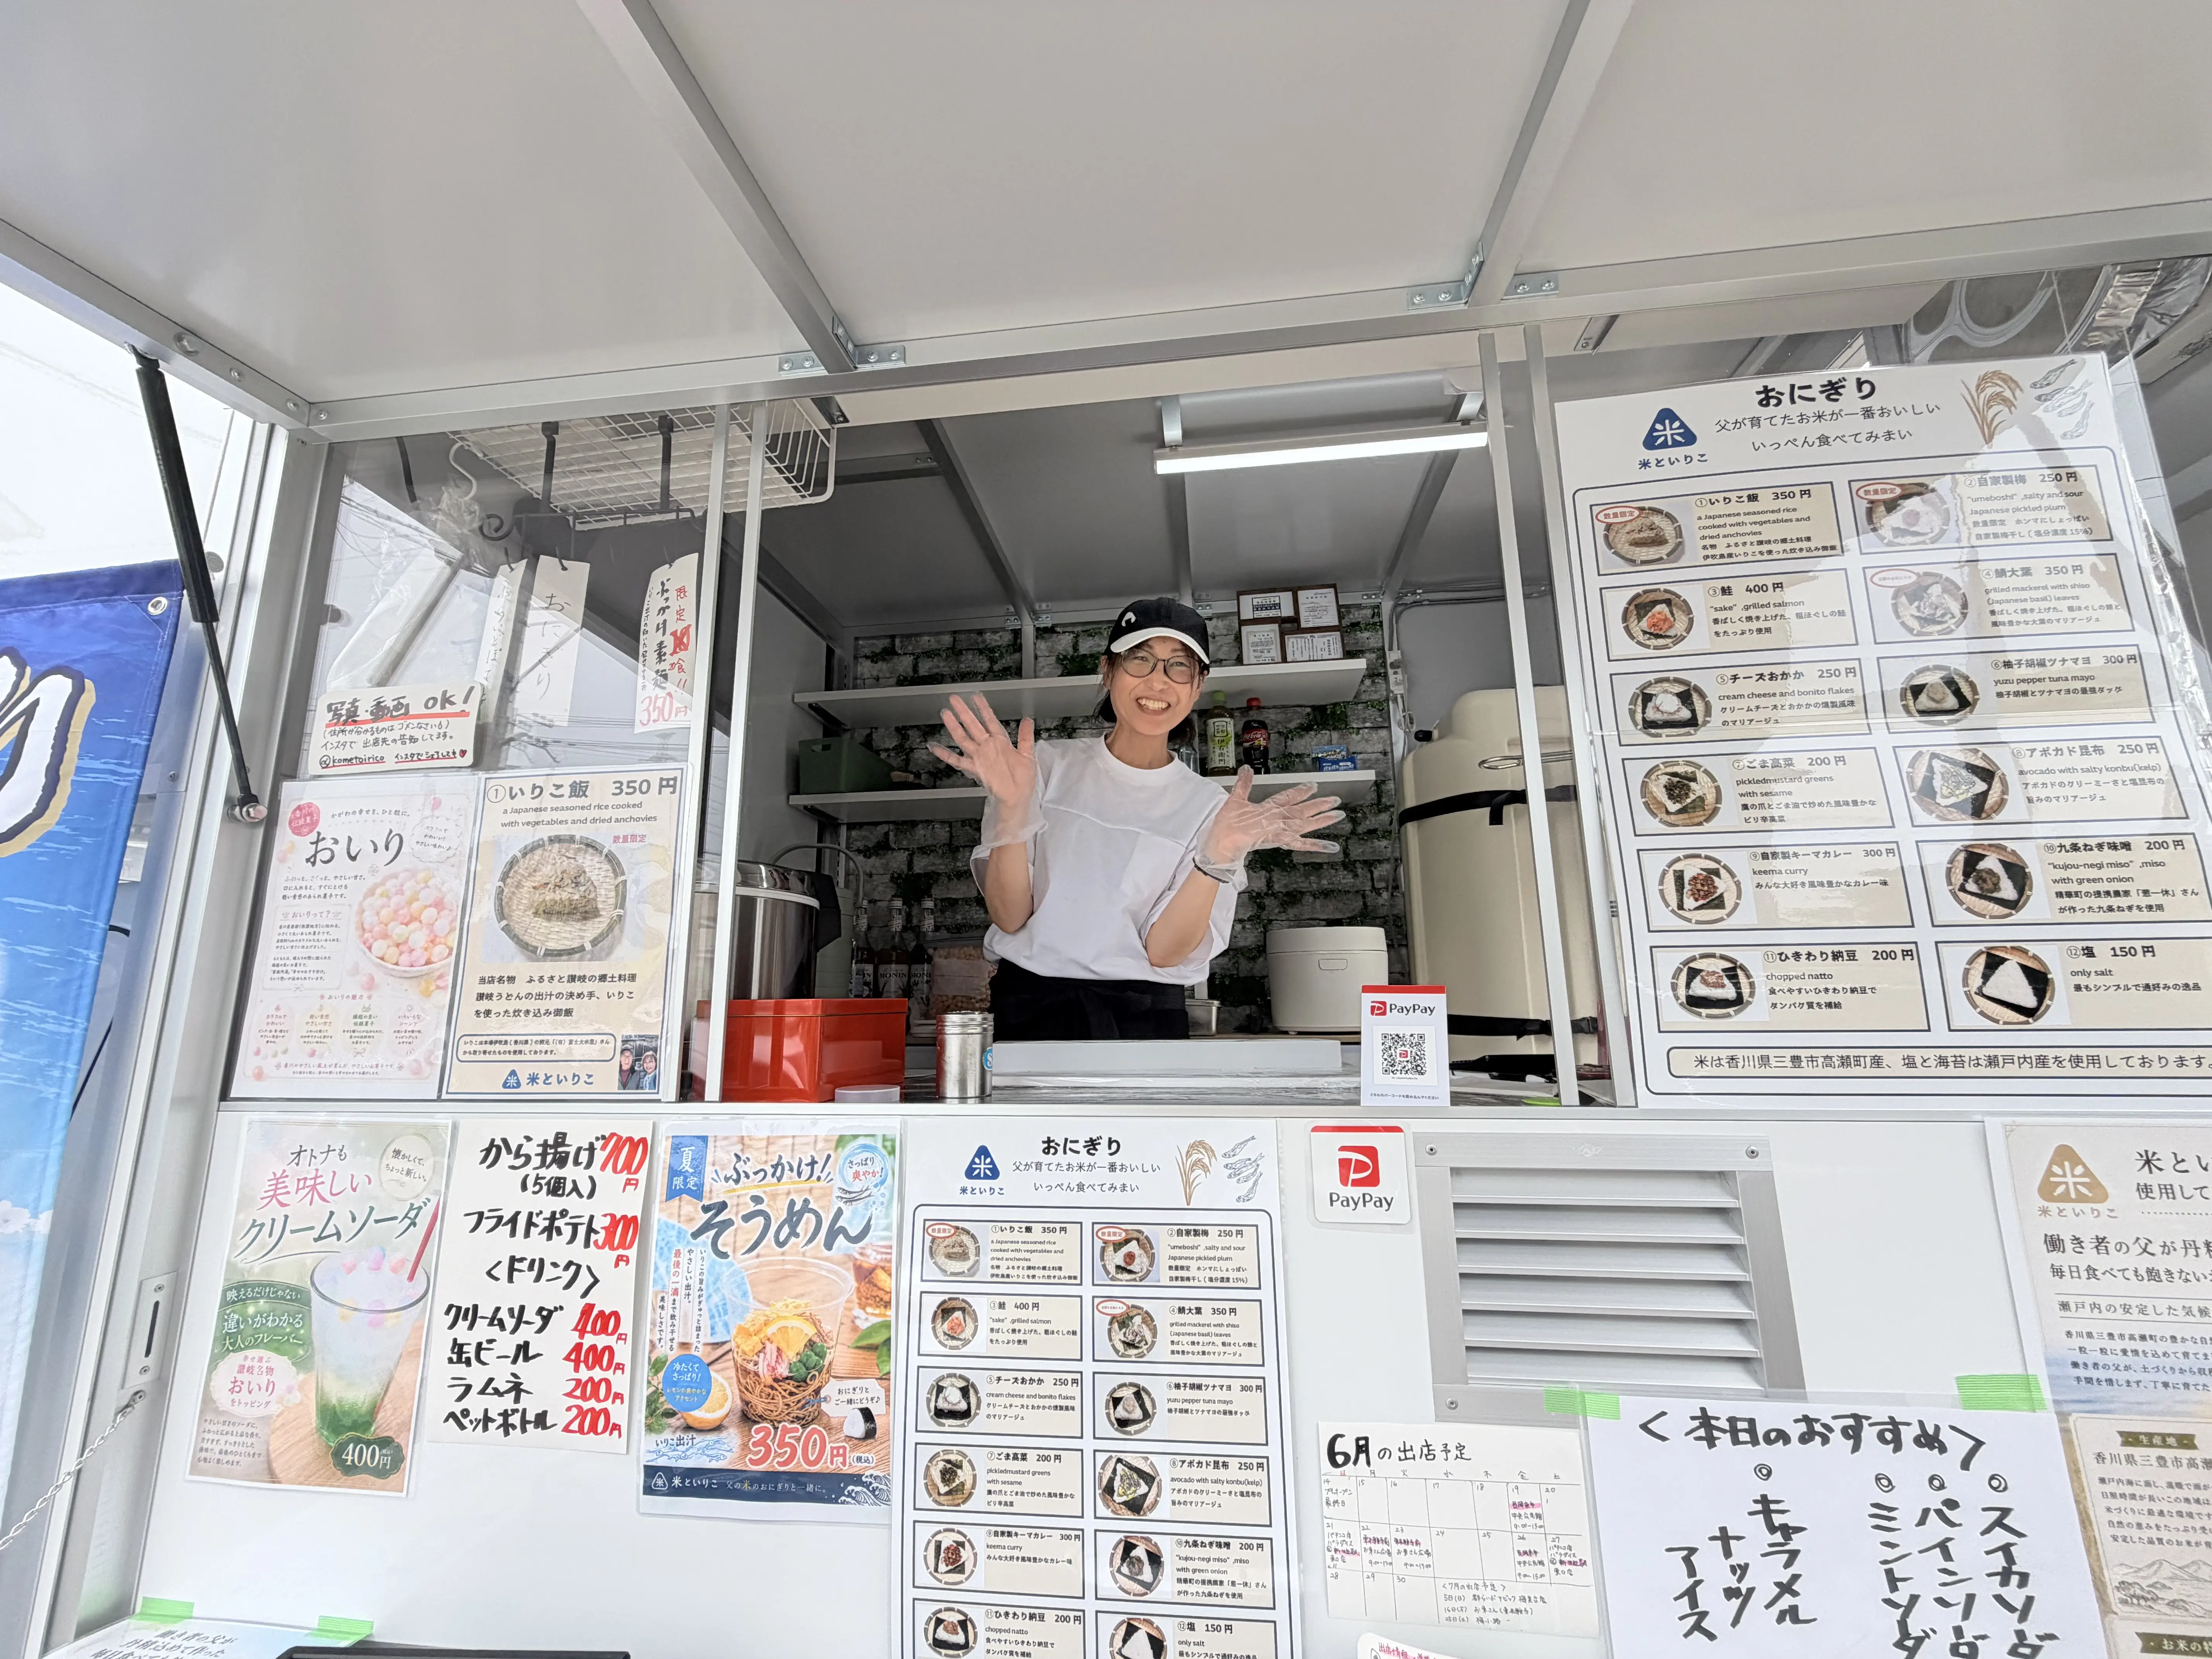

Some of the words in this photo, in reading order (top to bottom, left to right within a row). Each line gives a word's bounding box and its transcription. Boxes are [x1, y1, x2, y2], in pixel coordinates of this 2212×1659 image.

[1756, 376, 1875, 407] おにぎり
[1715, 404, 1940, 433] 父が育てたお米が一番おいしい
[1752, 430, 1912, 451] いっぺん食べてみまい
[1638, 453, 1708, 470] 米といりこ
[640, 692, 688, 726] 350円
[1807, 757, 1831, 766] 200
[1834, 755, 1846, 766] 円
[611, 779, 651, 796] 350
[658, 776, 677, 795] 円
[1736, 776, 1802, 787] pickledmustard
[1805, 775, 1834, 784] greens
[509, 807, 548, 815] Japanese
[550, 803, 592, 812] seasoned
[611, 801, 642, 809] cooked
[521, 818, 568, 828] vegetables
[589, 816, 612, 824] dried
[614, 814, 657, 823] anchovies
[306, 828, 403, 867] おいり
[613, 834, 646, 844] 数量限定
[1784, 868, 1808, 877] curry
[1872, 950, 1897, 960] 200
[1901, 949, 1914, 961] 円
[2110, 946, 2137, 957] 150
[2141, 945, 2156, 958] 円
[478, 975, 516, 985] 当店名物
[1766, 972, 1806, 982] chopped
[2070, 969, 2092, 978] only
[2094, 968, 2114, 976] salt
[474, 1008, 574, 1018] を使った炊き込み御飯
[1389, 1003, 1436, 1016] PayPay
[526, 1072, 594, 1086] 米といりこ
[479, 1132, 600, 1170] から揚げ
[1042, 1136, 1120, 1156] おにぎり
[287, 1145, 347, 1167] オトナも
[678, 1146, 696, 1173] 夏
[848, 1157, 874, 1169] さっぱり
[386, 1163, 426, 1182] ちょっと新しい。
[724, 1151, 831, 1185] ぶっかけ!
[852, 1167, 884, 1182] 爽やか!
[1013, 1161, 1161, 1173] 父が育てたお米が一番おいしい
[261, 1169, 371, 1208] 美味しい
[622, 1177, 639, 1193] 円
[672, 1175, 699, 1190] 限定
[959, 1185, 1004, 1195] 米といりこ
[1034, 1181, 1139, 1193] いっぺん食べてみまい
[1330, 1193, 1393, 1211] PayPay
[2038, 1206, 2119, 1219] 米といりこ
[234, 1197, 431, 1264] クリームソーダ
[464, 1208, 600, 1249] フライドポテト
[593, 1213, 639, 1251] 300
[691, 1194, 873, 1260] そうめん
[1235, 1229, 1243, 1238] 円
[684, 1248, 694, 1304] やさしい出汁。
[227, 1287, 300, 1303] 映えるだけじゃない
[668, 1249, 681, 1352] 最後の一滴まで飲み干せる
[694, 1249, 706, 1352] いりこの旨みがぎゅっと詰まった
[1032, 1302, 1039, 1311] 円
[222, 1309, 303, 1336] 違いがわかる
[444, 1304, 564, 1335] クリームソーダ
[657, 1295, 665, 1348] 美味しさです。
[221, 1331, 303, 1353] 大人のフレーバー
[447, 1338, 543, 1367] 缶ビール
[673, 1362, 699, 1372] 冷たくて
[229, 1377, 275, 1395] おいり
[673, 1372, 701, 1382] さっぱり!
[1053, 1378, 1068, 1386] 250
[1071, 1378, 1079, 1387] 円
[447, 1372, 533, 1404] ラムネ
[838, 1386, 869, 1395] おにぎりと
[230, 1398, 271, 1408] をトッピング
[443, 1408, 557, 1437] ペットボトル
[656, 1434, 696, 1447] いりこ出汁
[1327, 1434, 1471, 1468] 6月の出店予定
[672, 1475, 718, 1488] 米といりこ
[726, 1479, 826, 1493] 父の米のおにぎりと一緒に。
[1747, 1494, 1817, 1625] キャラメル
[1708, 1526, 1756, 1628] ナッツ
[1665, 1547, 1717, 1642] アイス
